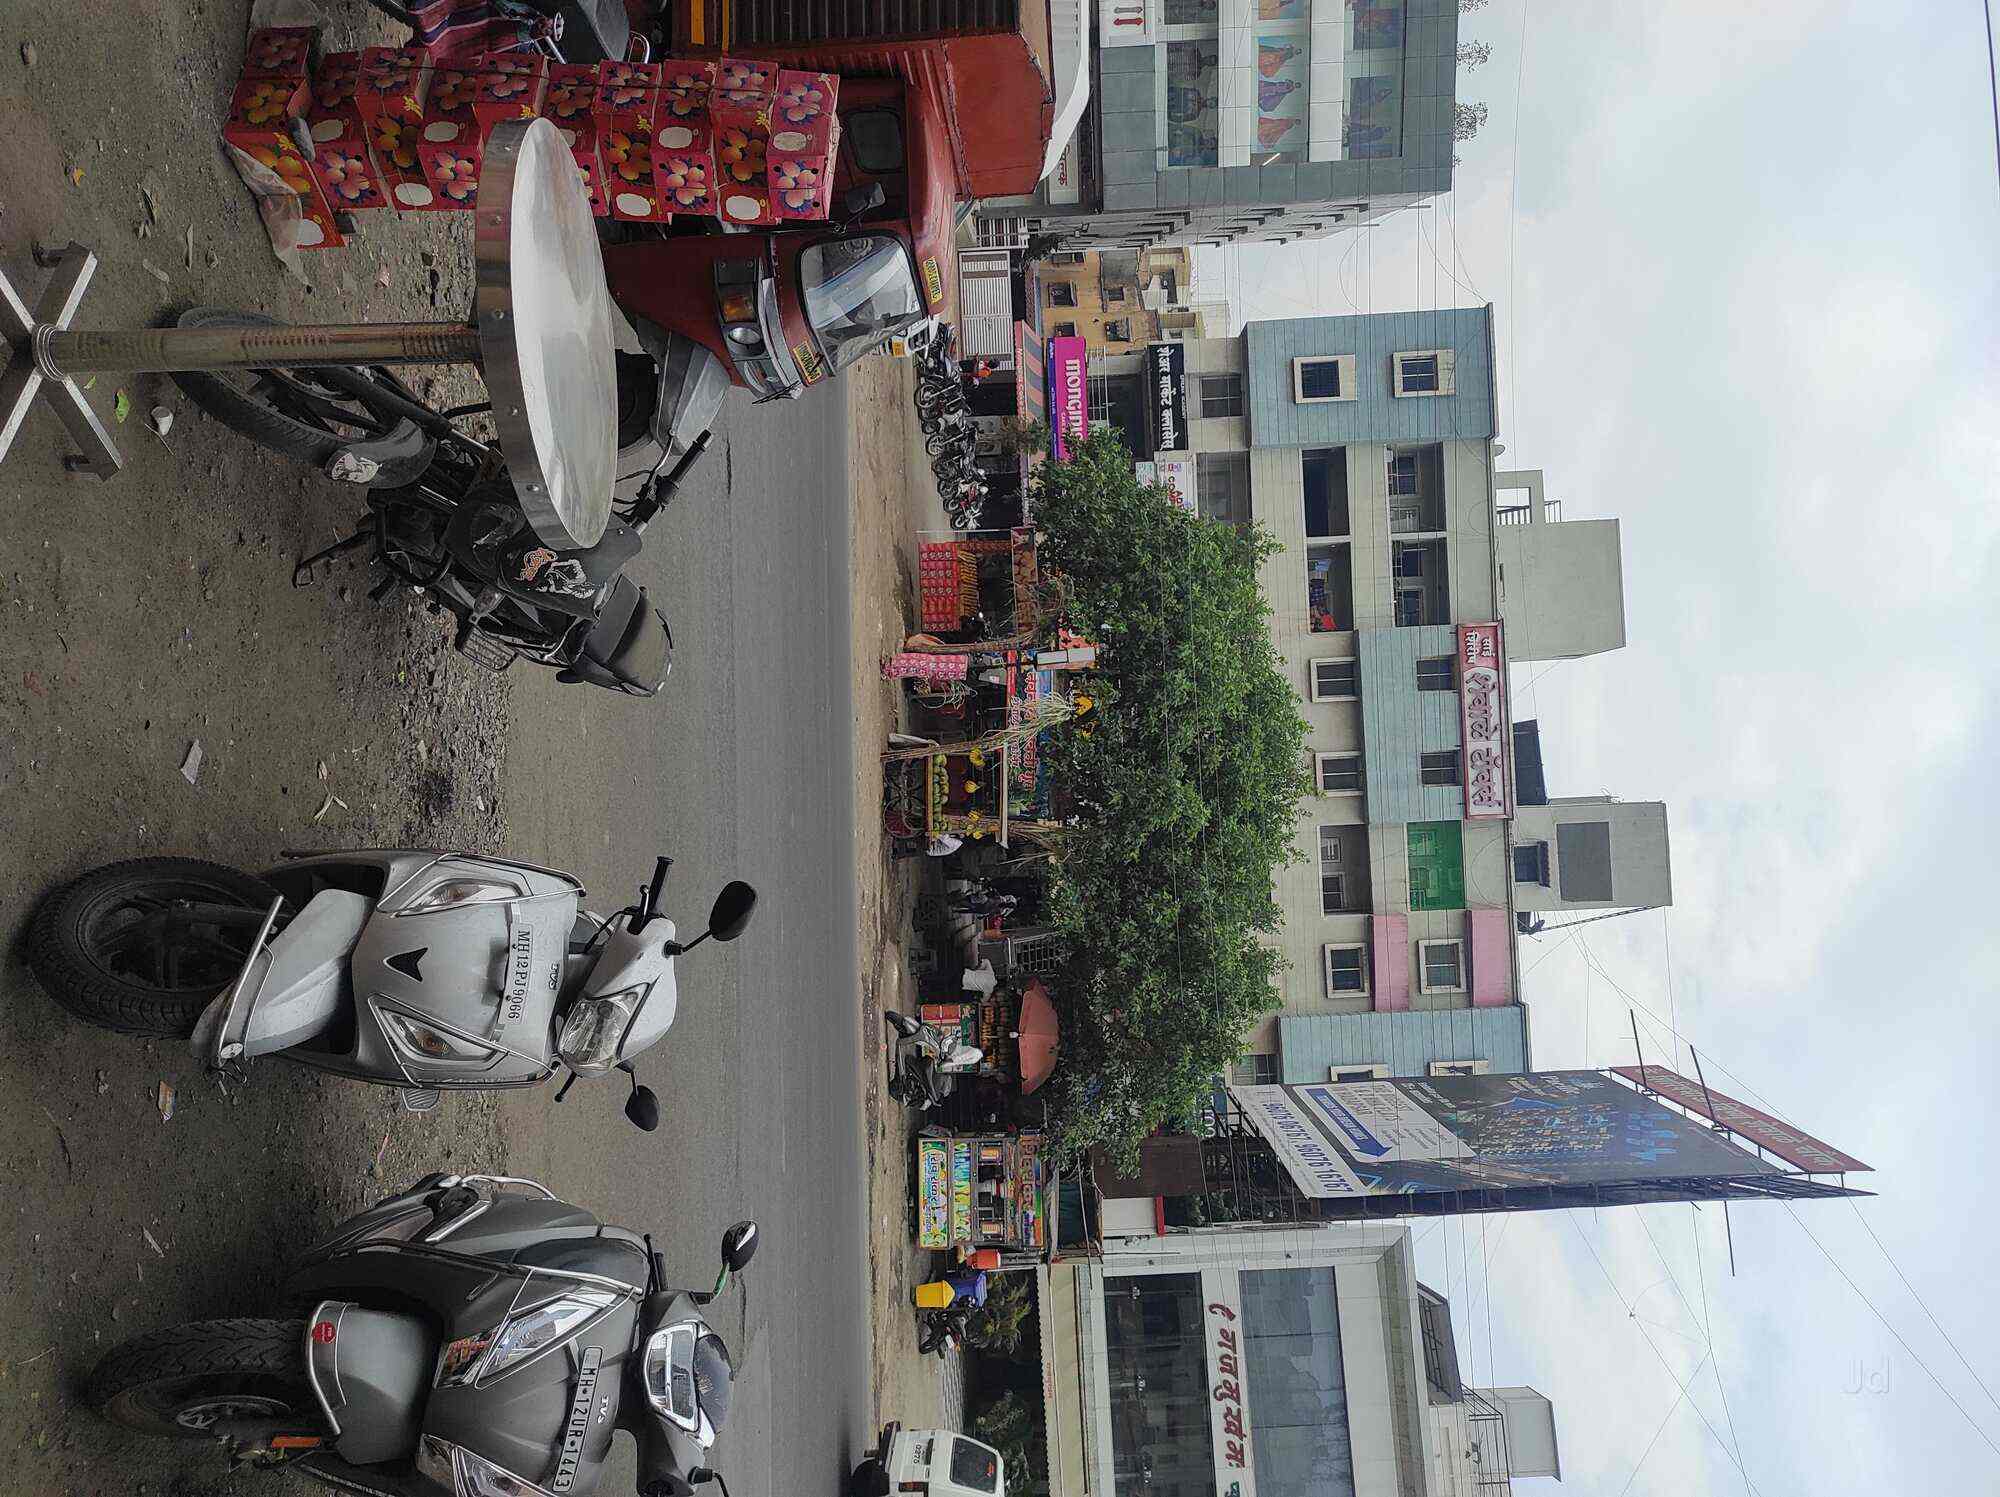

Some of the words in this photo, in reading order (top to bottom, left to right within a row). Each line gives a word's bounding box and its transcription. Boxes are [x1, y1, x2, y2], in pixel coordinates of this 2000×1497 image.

[1159, 375, 1177, 406] मार्केट
[1466, 672, 1500, 741] शेवाळे
[548, 963, 560, 991] TVS
[1314, 1169, 1354, 1193] 16767
[597, 1395, 609, 1424] TVS
